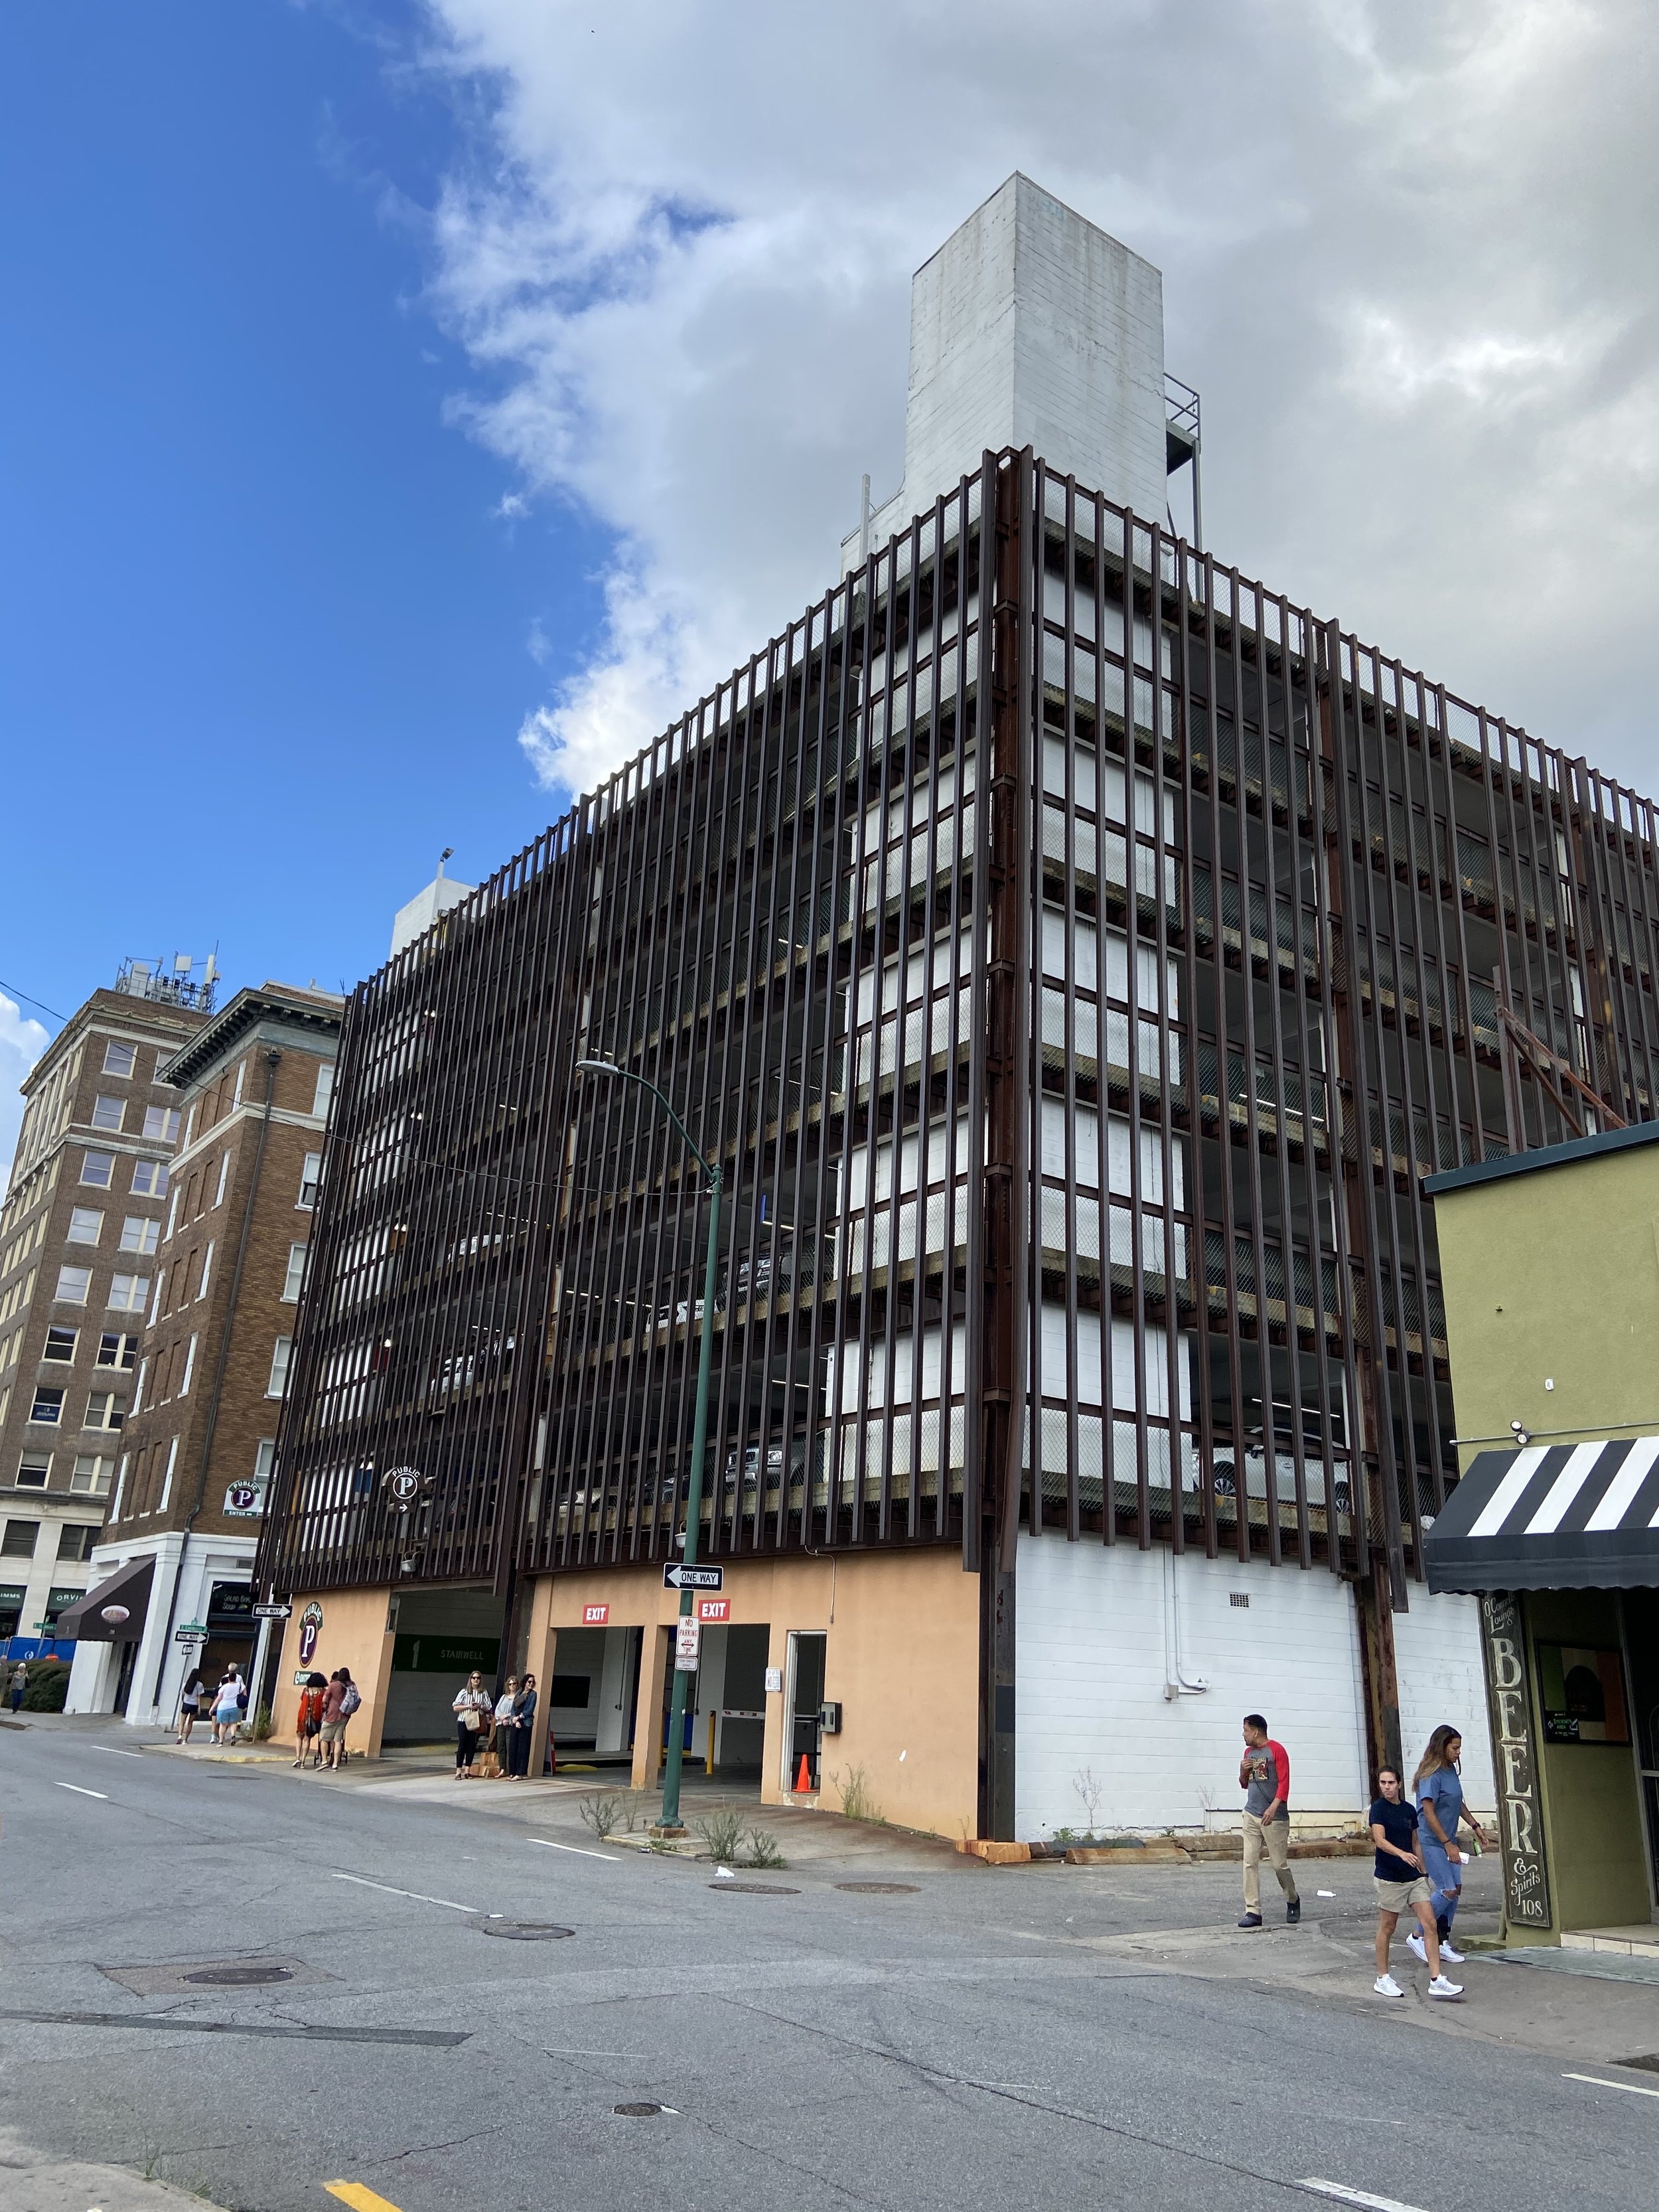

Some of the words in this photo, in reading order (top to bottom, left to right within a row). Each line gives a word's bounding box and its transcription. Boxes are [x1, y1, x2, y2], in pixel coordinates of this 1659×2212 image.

[392, 1465, 420, 1478] PUBLIC
[233, 1481, 257, 1491] PUBLIC
[398, 1477, 413, 1495] P
[236, 1489, 252, 1506] P
[682, 1572, 697, 1583] ONE
[699, 1573, 717, 1584] WAY
[303, 1603, 322, 1622] PUBLIC
[585, 1607, 607, 1621] EXIT
[701, 1602, 726, 1617] EXIT
[1489, 1606, 1515, 1635] Lounge
[301, 1625, 315, 1657] P
[440, 1650, 484, 1660] STAIRWELL
[1491, 1637, 1538, 1854] BEER
[1510, 1872, 1541, 1906] Spirits
[1522, 1899, 1543, 1917] 108
